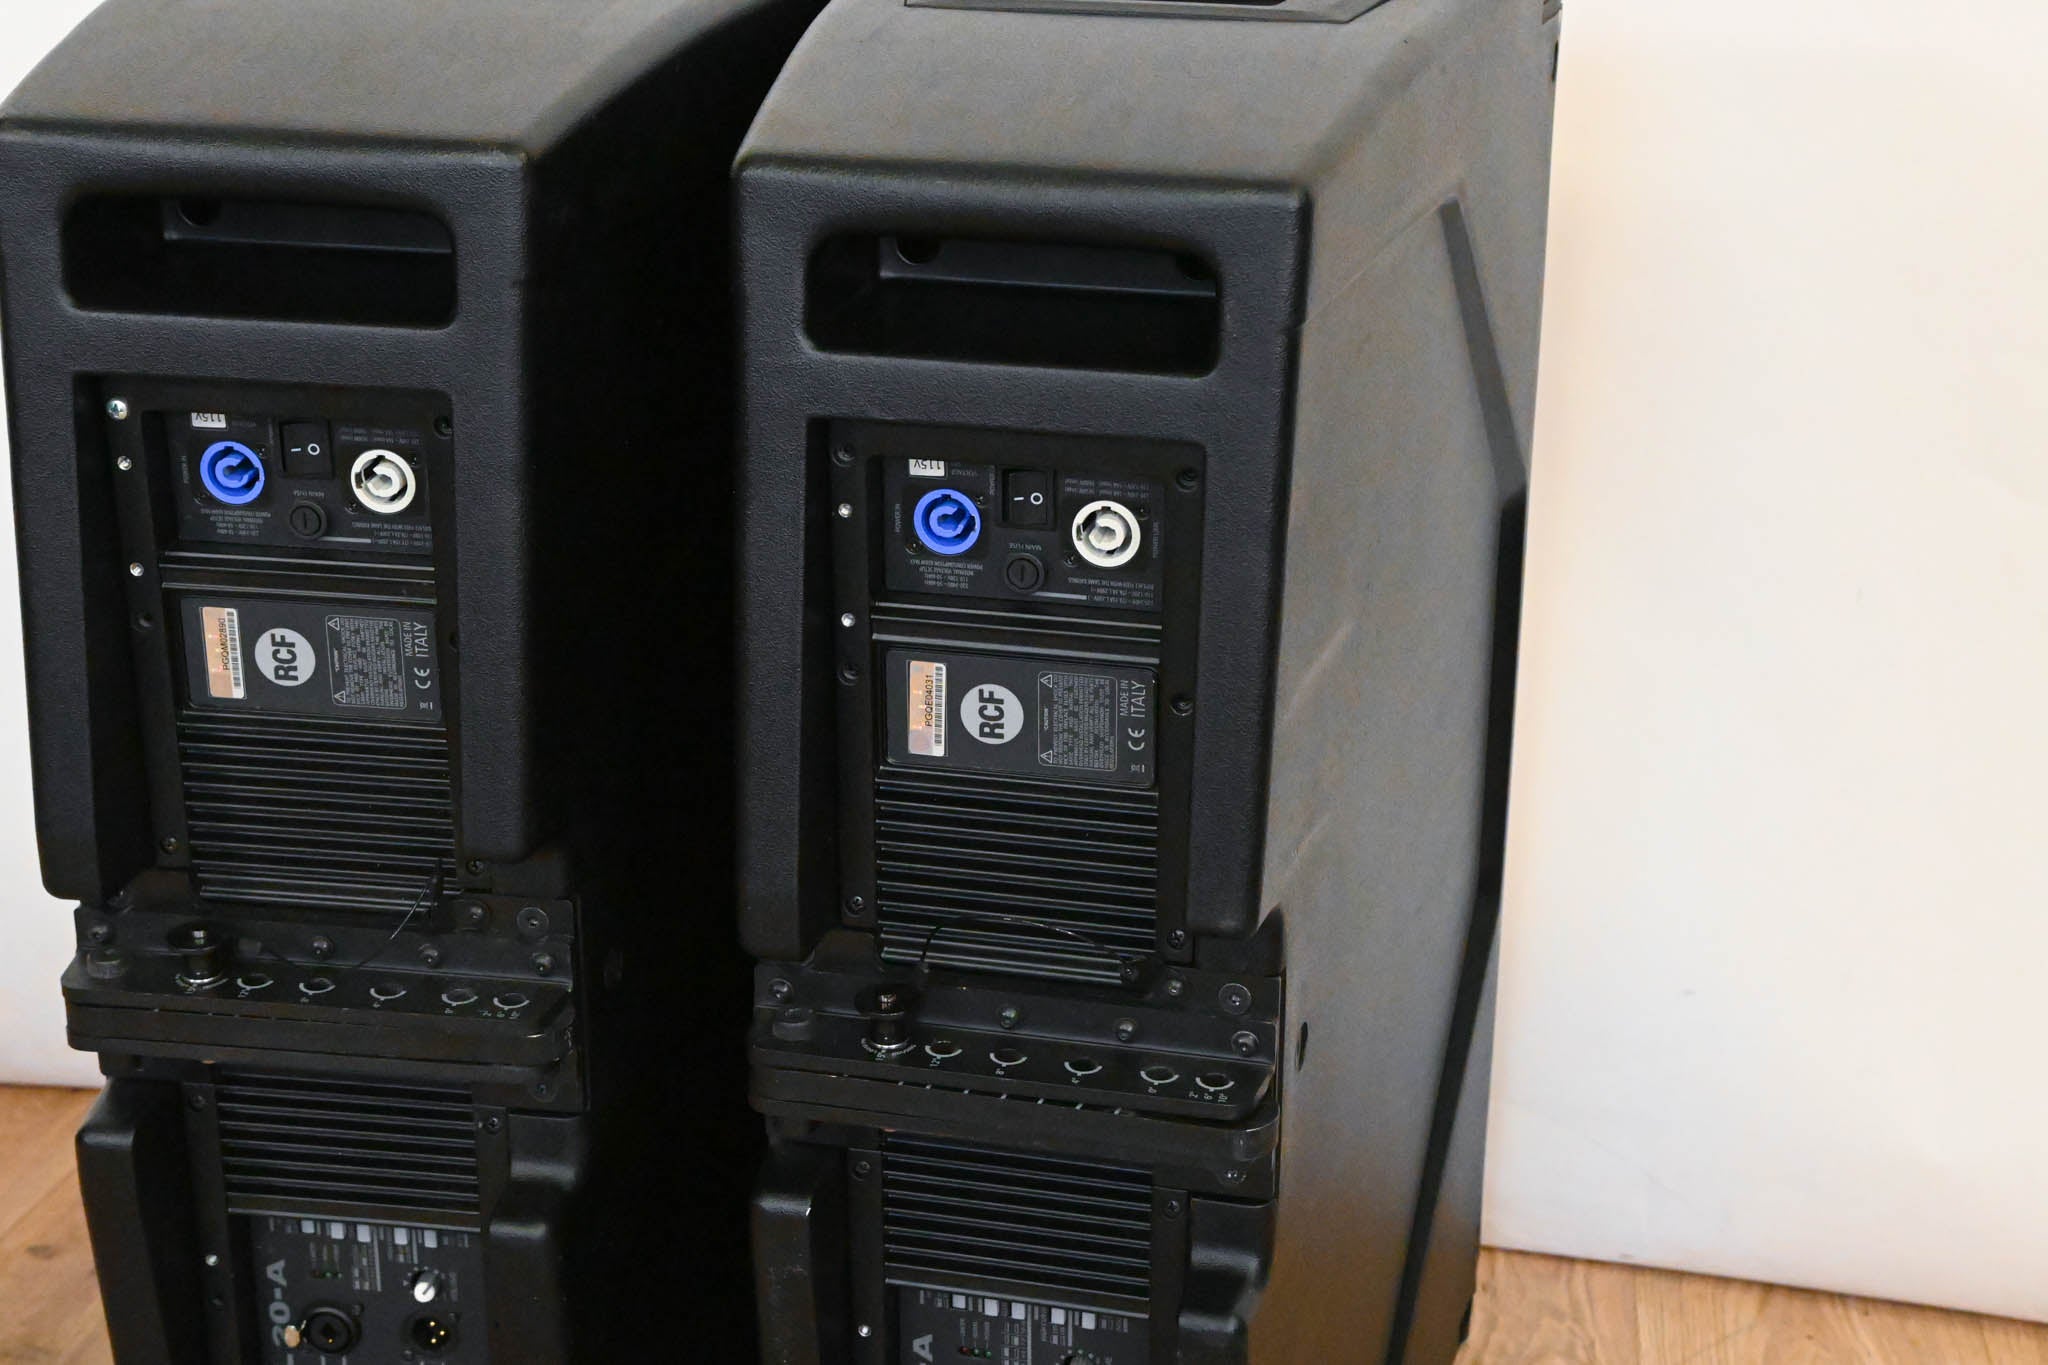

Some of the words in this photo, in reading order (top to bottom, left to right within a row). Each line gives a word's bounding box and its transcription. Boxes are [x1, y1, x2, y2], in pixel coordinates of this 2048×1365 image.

[195, 413, 222, 422] 115V
[914, 459, 941, 470] 115V
[403, 621, 411, 631] IN
[403, 633, 413, 657] MADE
[413, 622, 429, 657] ITALY
[271, 633, 299, 682] RCF
[1120, 680, 1129, 690] IN
[925, 675, 934, 727] PGQE04031
[1120, 691, 1129, 717] MADE
[1131, 680, 1146, 718] ITALY
[978, 688, 1004, 740] RCF
